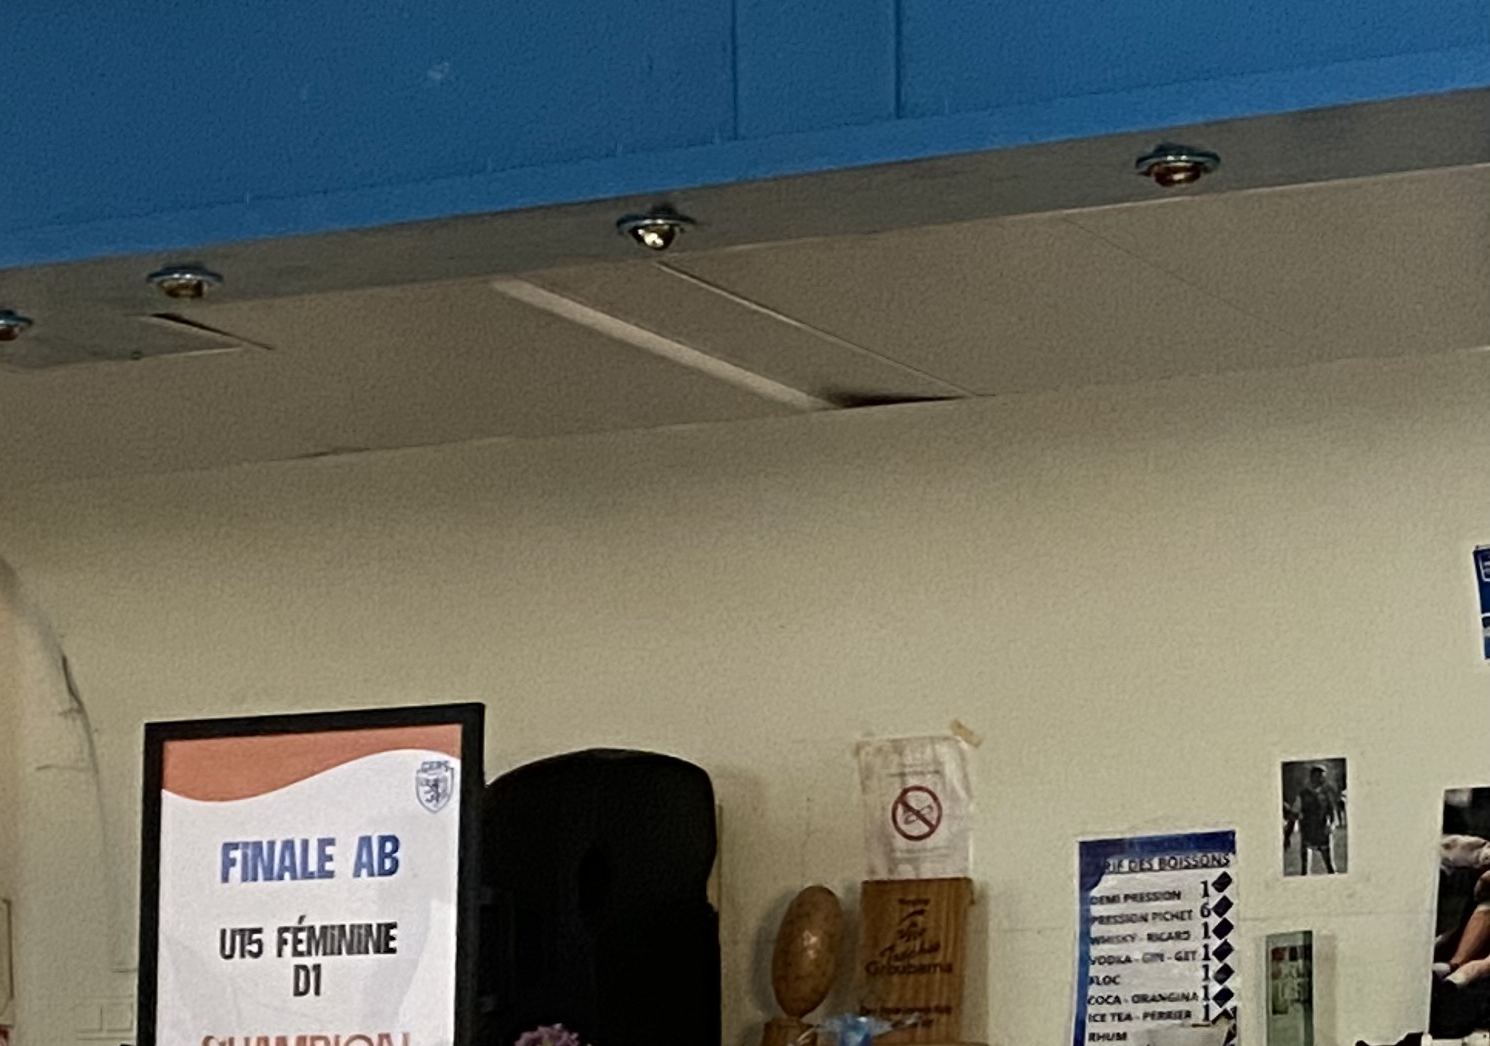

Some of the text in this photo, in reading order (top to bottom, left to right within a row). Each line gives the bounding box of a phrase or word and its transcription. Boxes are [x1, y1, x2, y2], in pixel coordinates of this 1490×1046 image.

[352, 834, 401, 878] AB
[1200, 903, 1212, 919] 6
[219, 927, 264, 960] U15
[293, 963, 322, 997] D1
